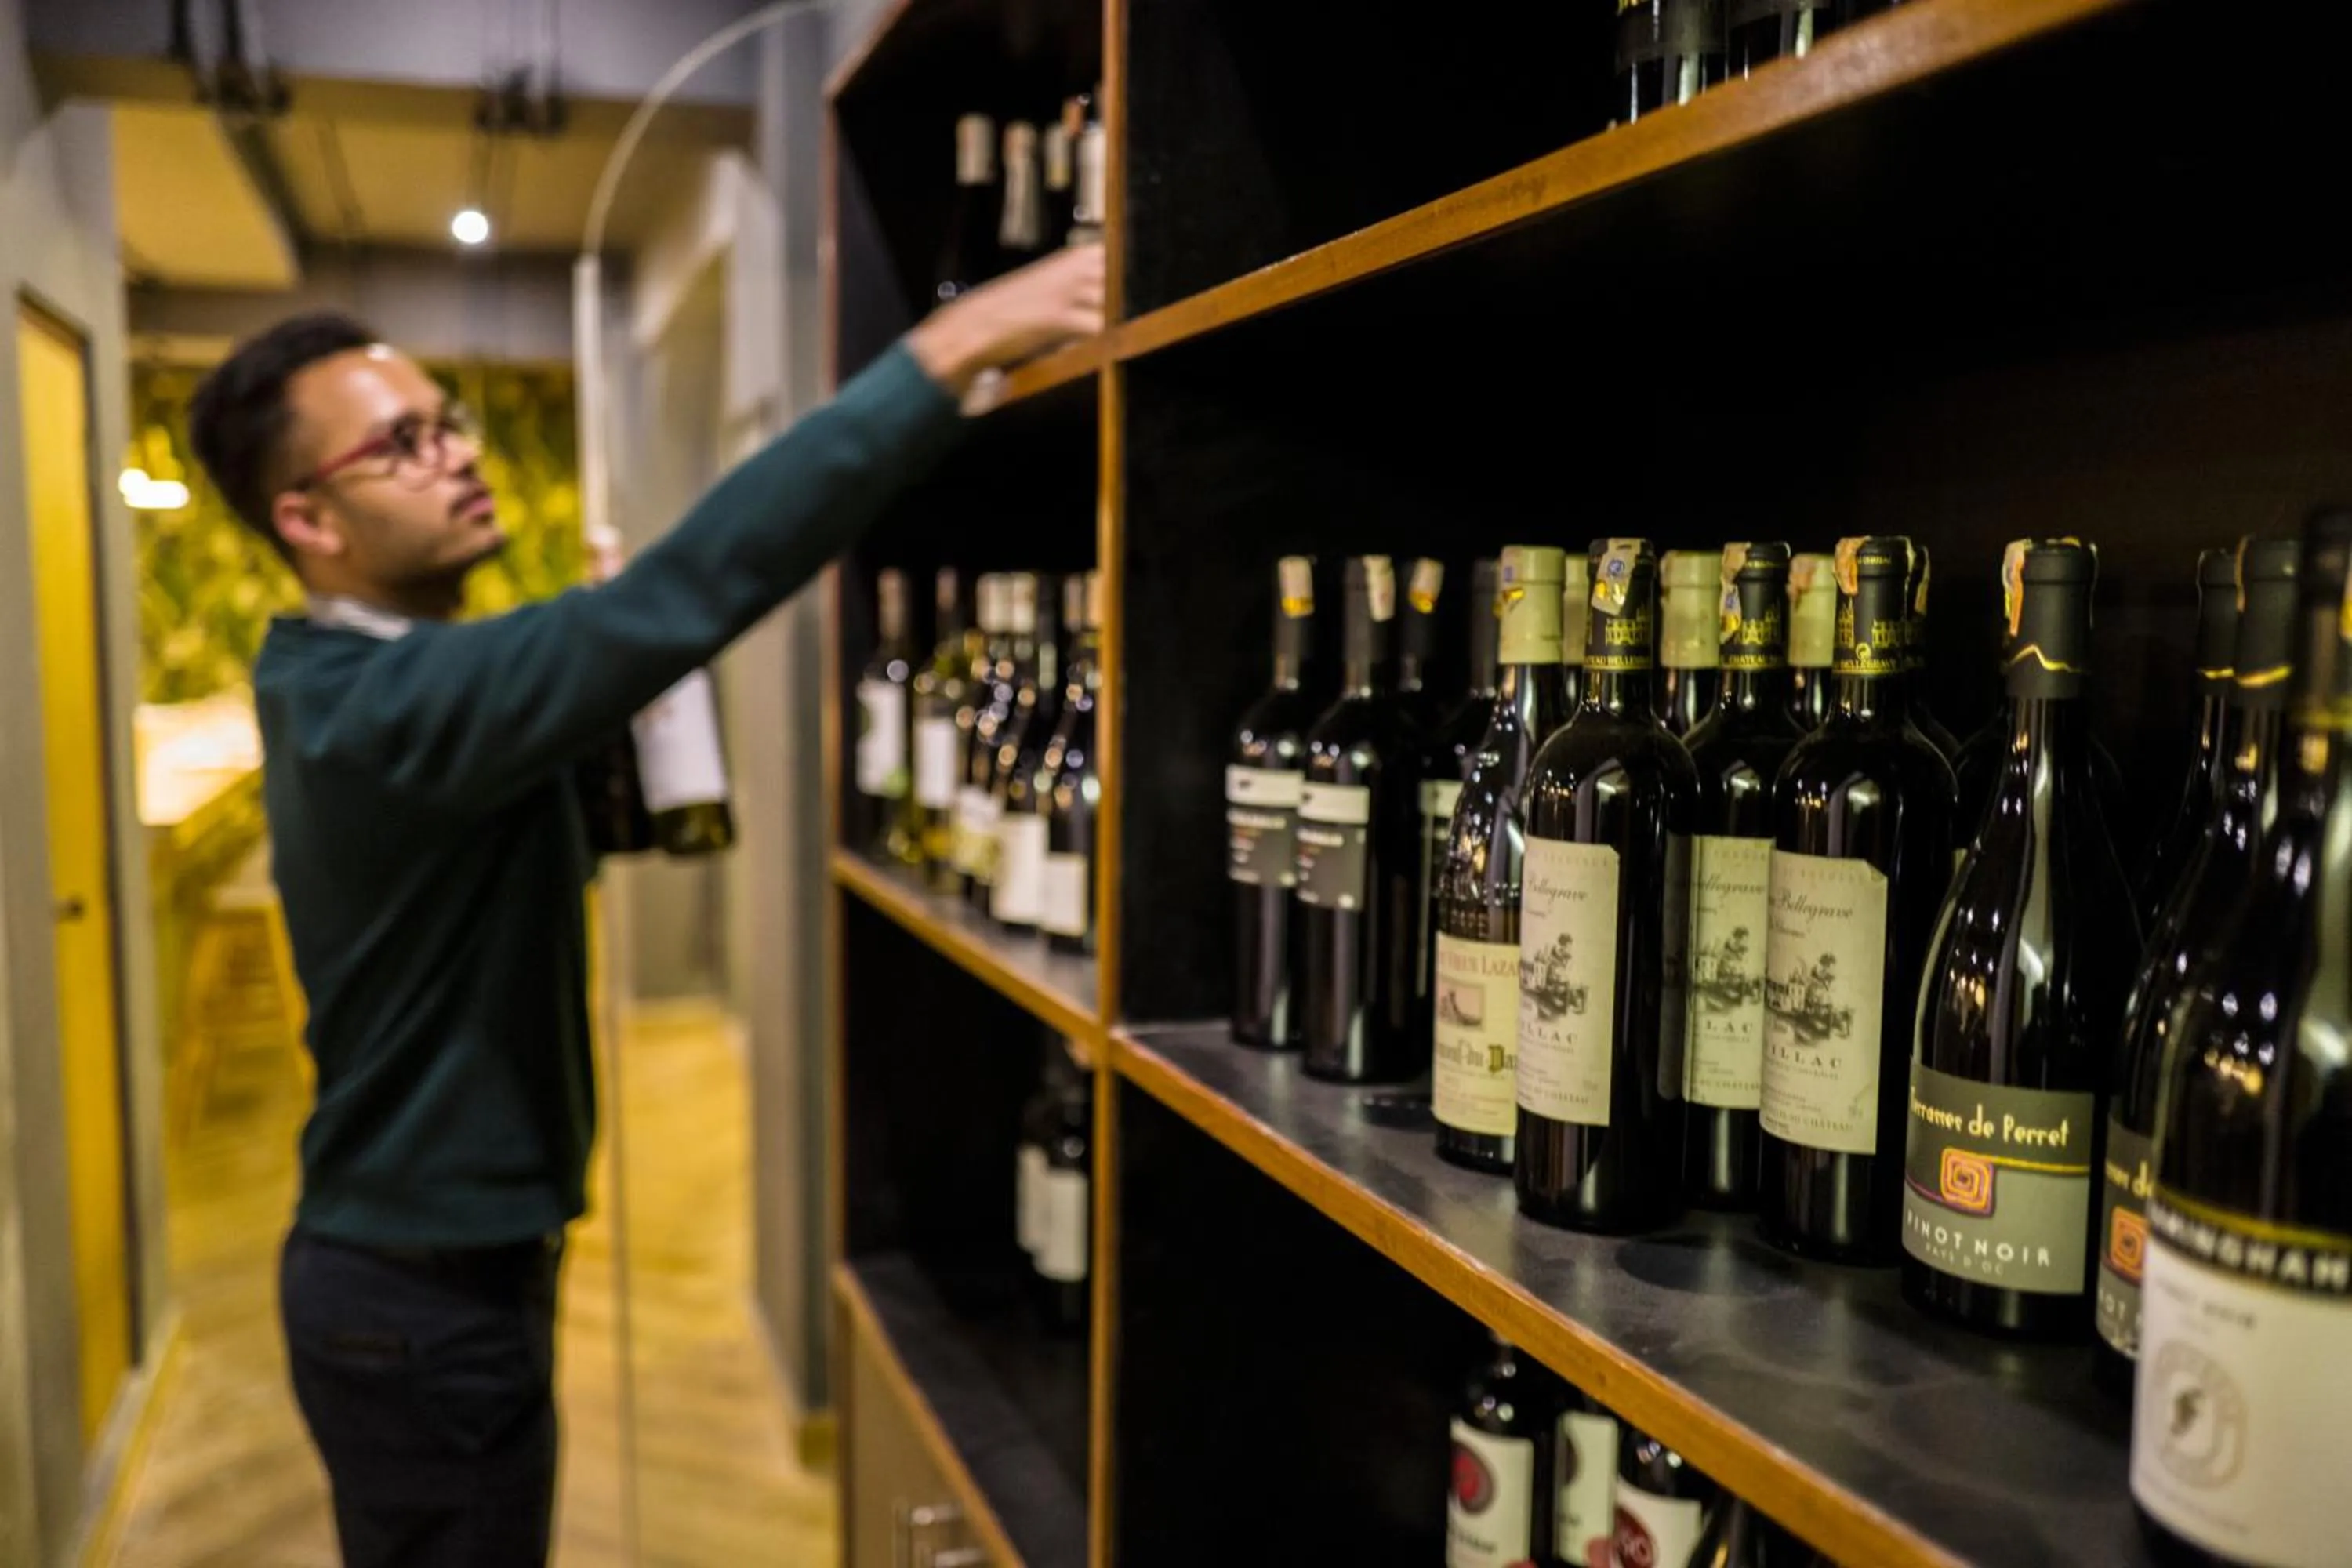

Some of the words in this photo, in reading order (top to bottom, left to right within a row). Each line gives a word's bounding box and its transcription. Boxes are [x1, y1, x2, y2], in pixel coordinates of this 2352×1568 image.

[1967, 1102, 1995, 1138] de
[2002, 1113, 2070, 1148] Perret
[1907, 1208, 1964, 1251] PINOT
[1974, 1238, 2052, 1268] NOIR
